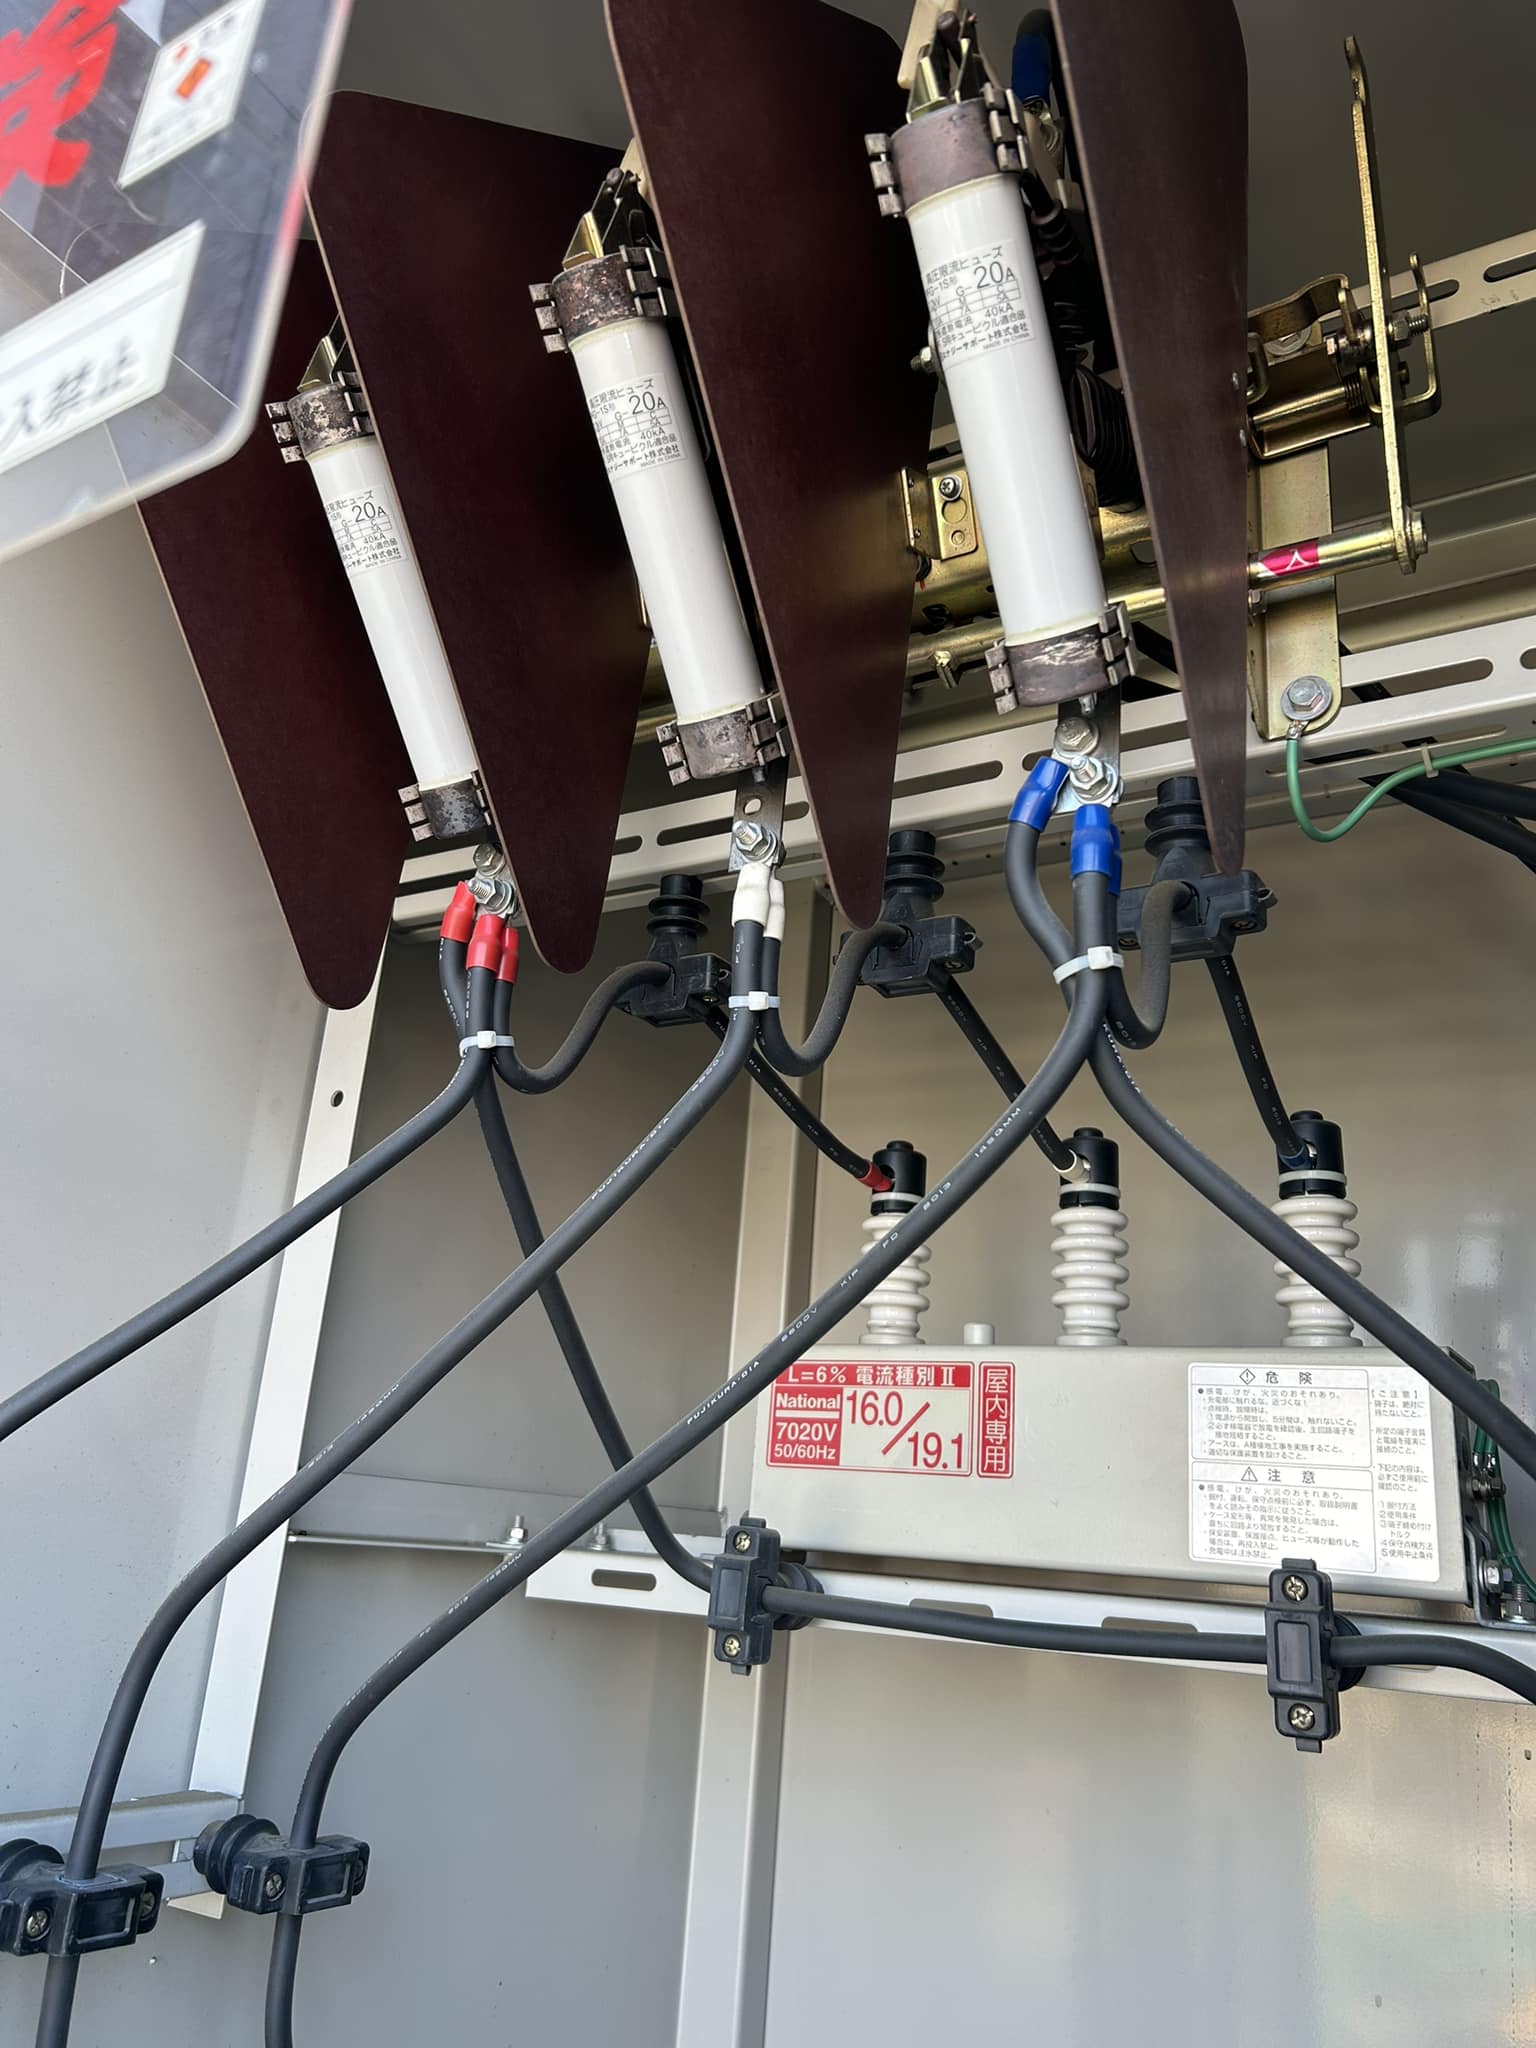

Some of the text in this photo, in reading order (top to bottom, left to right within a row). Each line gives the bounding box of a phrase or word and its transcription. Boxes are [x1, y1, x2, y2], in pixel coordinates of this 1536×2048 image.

[776, 1392, 841, 1410] National
[846, 1389, 903, 1427] 16.0
[775, 1421, 838, 1442] 7020V
[983, 1367, 1009, 1473] 屋内専用
[774, 1443, 837, 1460] 50/60Hz
[907, 1432, 963, 1469] 19.1
